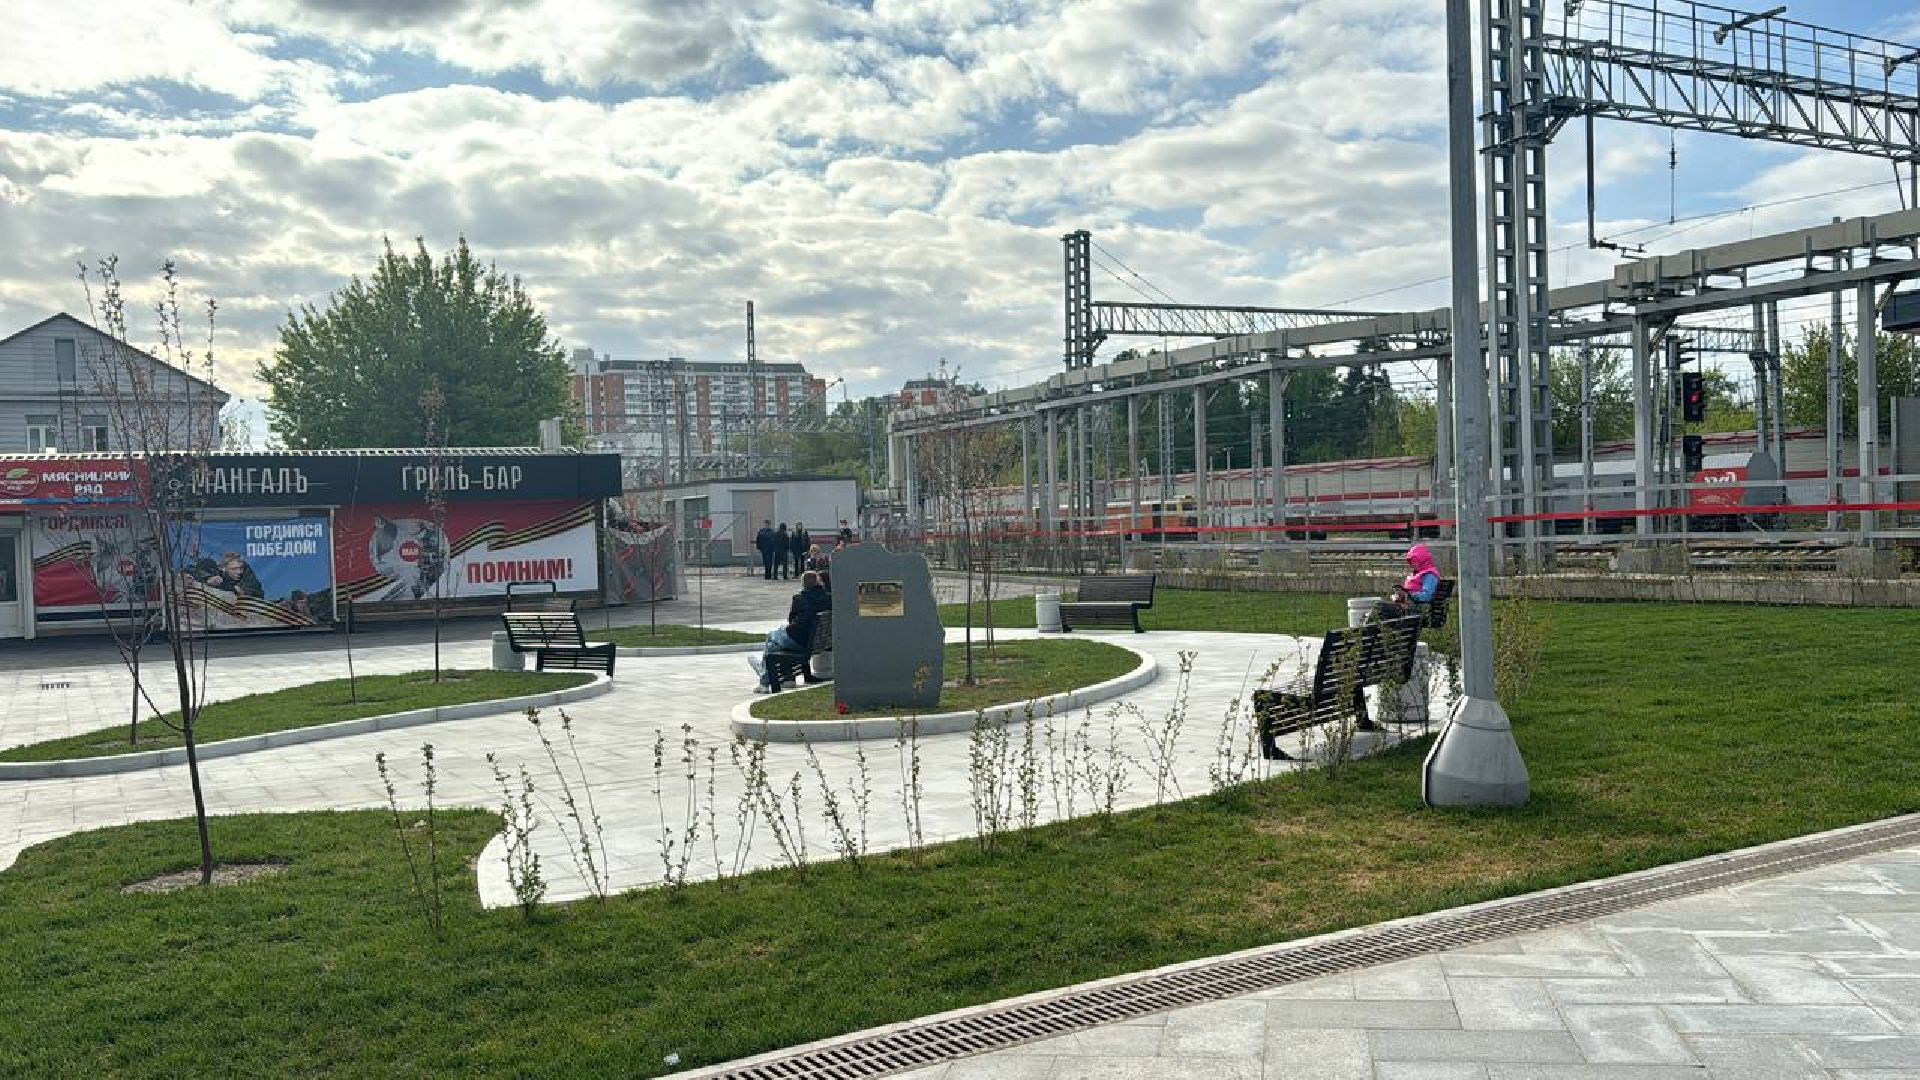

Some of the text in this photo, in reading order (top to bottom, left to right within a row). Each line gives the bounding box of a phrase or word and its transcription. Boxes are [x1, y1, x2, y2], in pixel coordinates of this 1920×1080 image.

[402, 465, 523, 490] ГРИЛЬ-БАР
[74, 483, 103, 494] РЯД
[246, 523, 323, 541] ГОРДИМСЯ
[246, 541, 317, 558] ПОБЕДОЙ!
[467, 558, 573, 584] ПОМНИМ!
